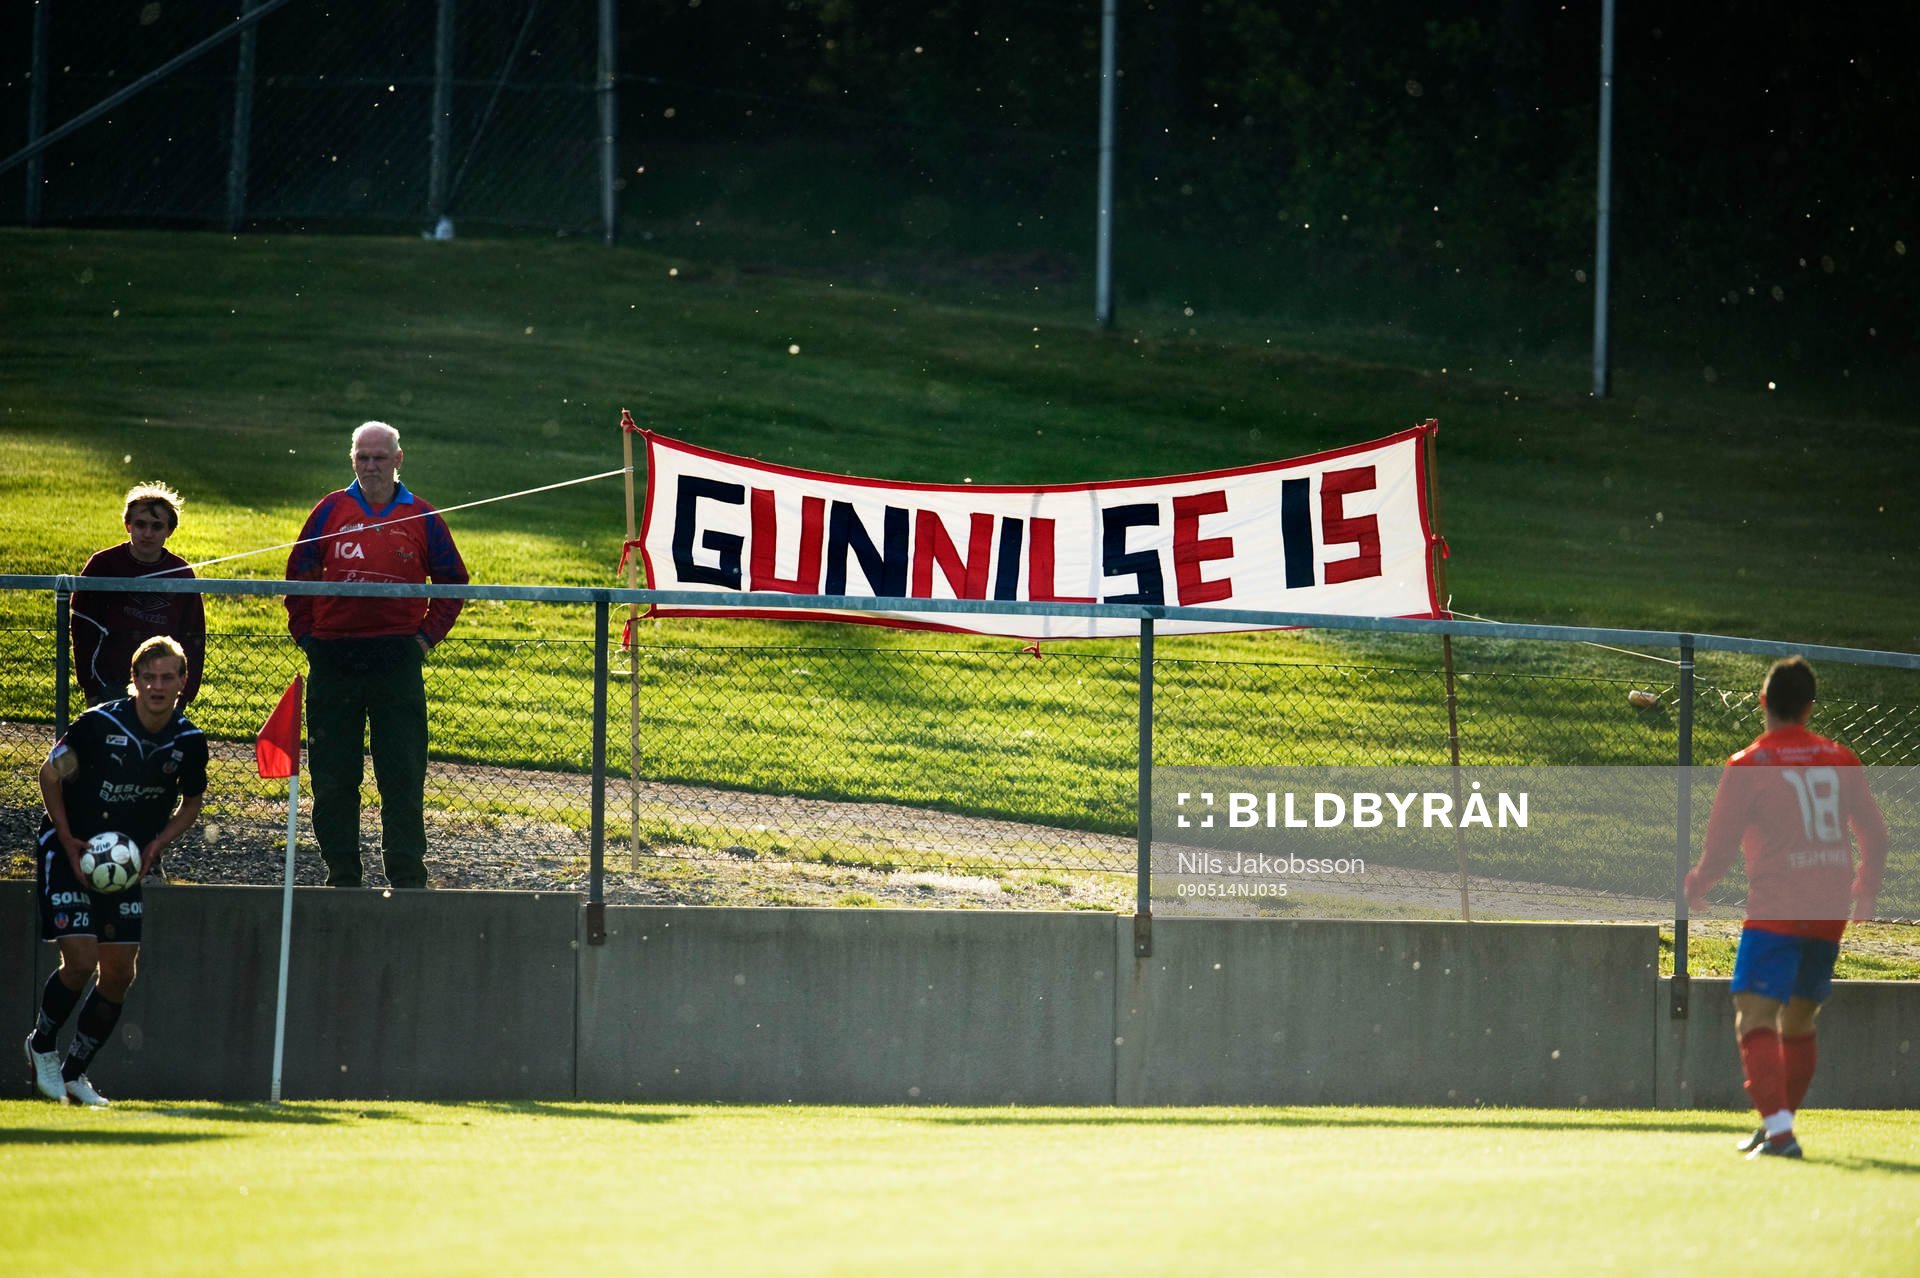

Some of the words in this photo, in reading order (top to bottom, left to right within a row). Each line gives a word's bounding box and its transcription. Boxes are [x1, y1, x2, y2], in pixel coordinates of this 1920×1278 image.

[671, 474, 1234, 607] GUNNILSE
[1281, 464, 1382, 590] IS
[335, 542, 365, 560] ICA
[99, 789, 139, 802] BANK
[1782, 767, 1842, 844] 18
[72, 911, 89, 927] 26
